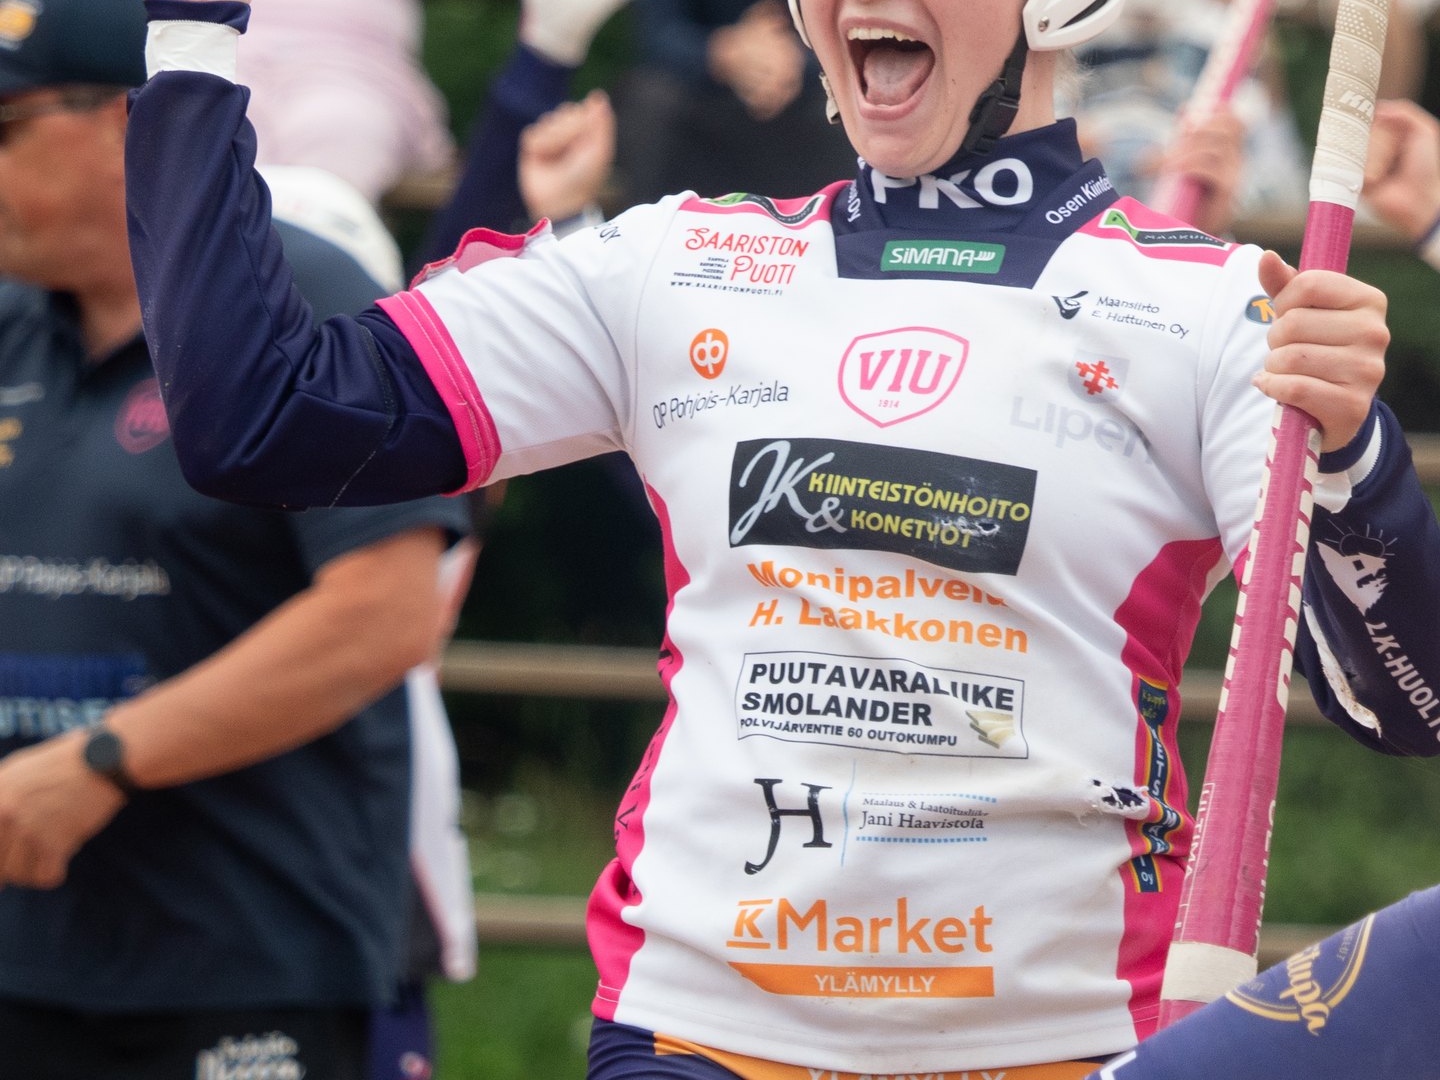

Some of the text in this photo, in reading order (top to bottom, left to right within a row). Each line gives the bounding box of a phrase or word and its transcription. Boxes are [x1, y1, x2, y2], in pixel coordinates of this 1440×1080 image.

[1045, 189, 1087, 224] Osen
[685, 227, 809, 258] SAARISTON
[729, 255, 796, 285] PUOTI
[1097, 296, 1160, 314] Maansiirto
[1106, 312, 1166, 332] Huttunen
[1169, 323, 1189, 339] Oy
[859, 348, 952, 395] VIU
[652, 380, 789, 430] OP Pohjois-Karjala
[877, 398, 900, 409] 1914
[1009, 395, 1154, 464] Liper
[807, 472, 1031, 522] KIINTEISTÖNHOITO
[804, 496, 848, 534] &
[749, 597, 1029, 654] H. Laakkonen
[748, 662, 1015, 711] PUUTAVARALIIKE
[741, 692, 933, 726] SMOLANDER
[740, 717, 958, 746] POLVIJÄRVENTIE 60 OUTOKUMPU
[859, 810, 985, 829] Jani Haavistola
[814, 971, 936, 993] YLÄMYLLY
